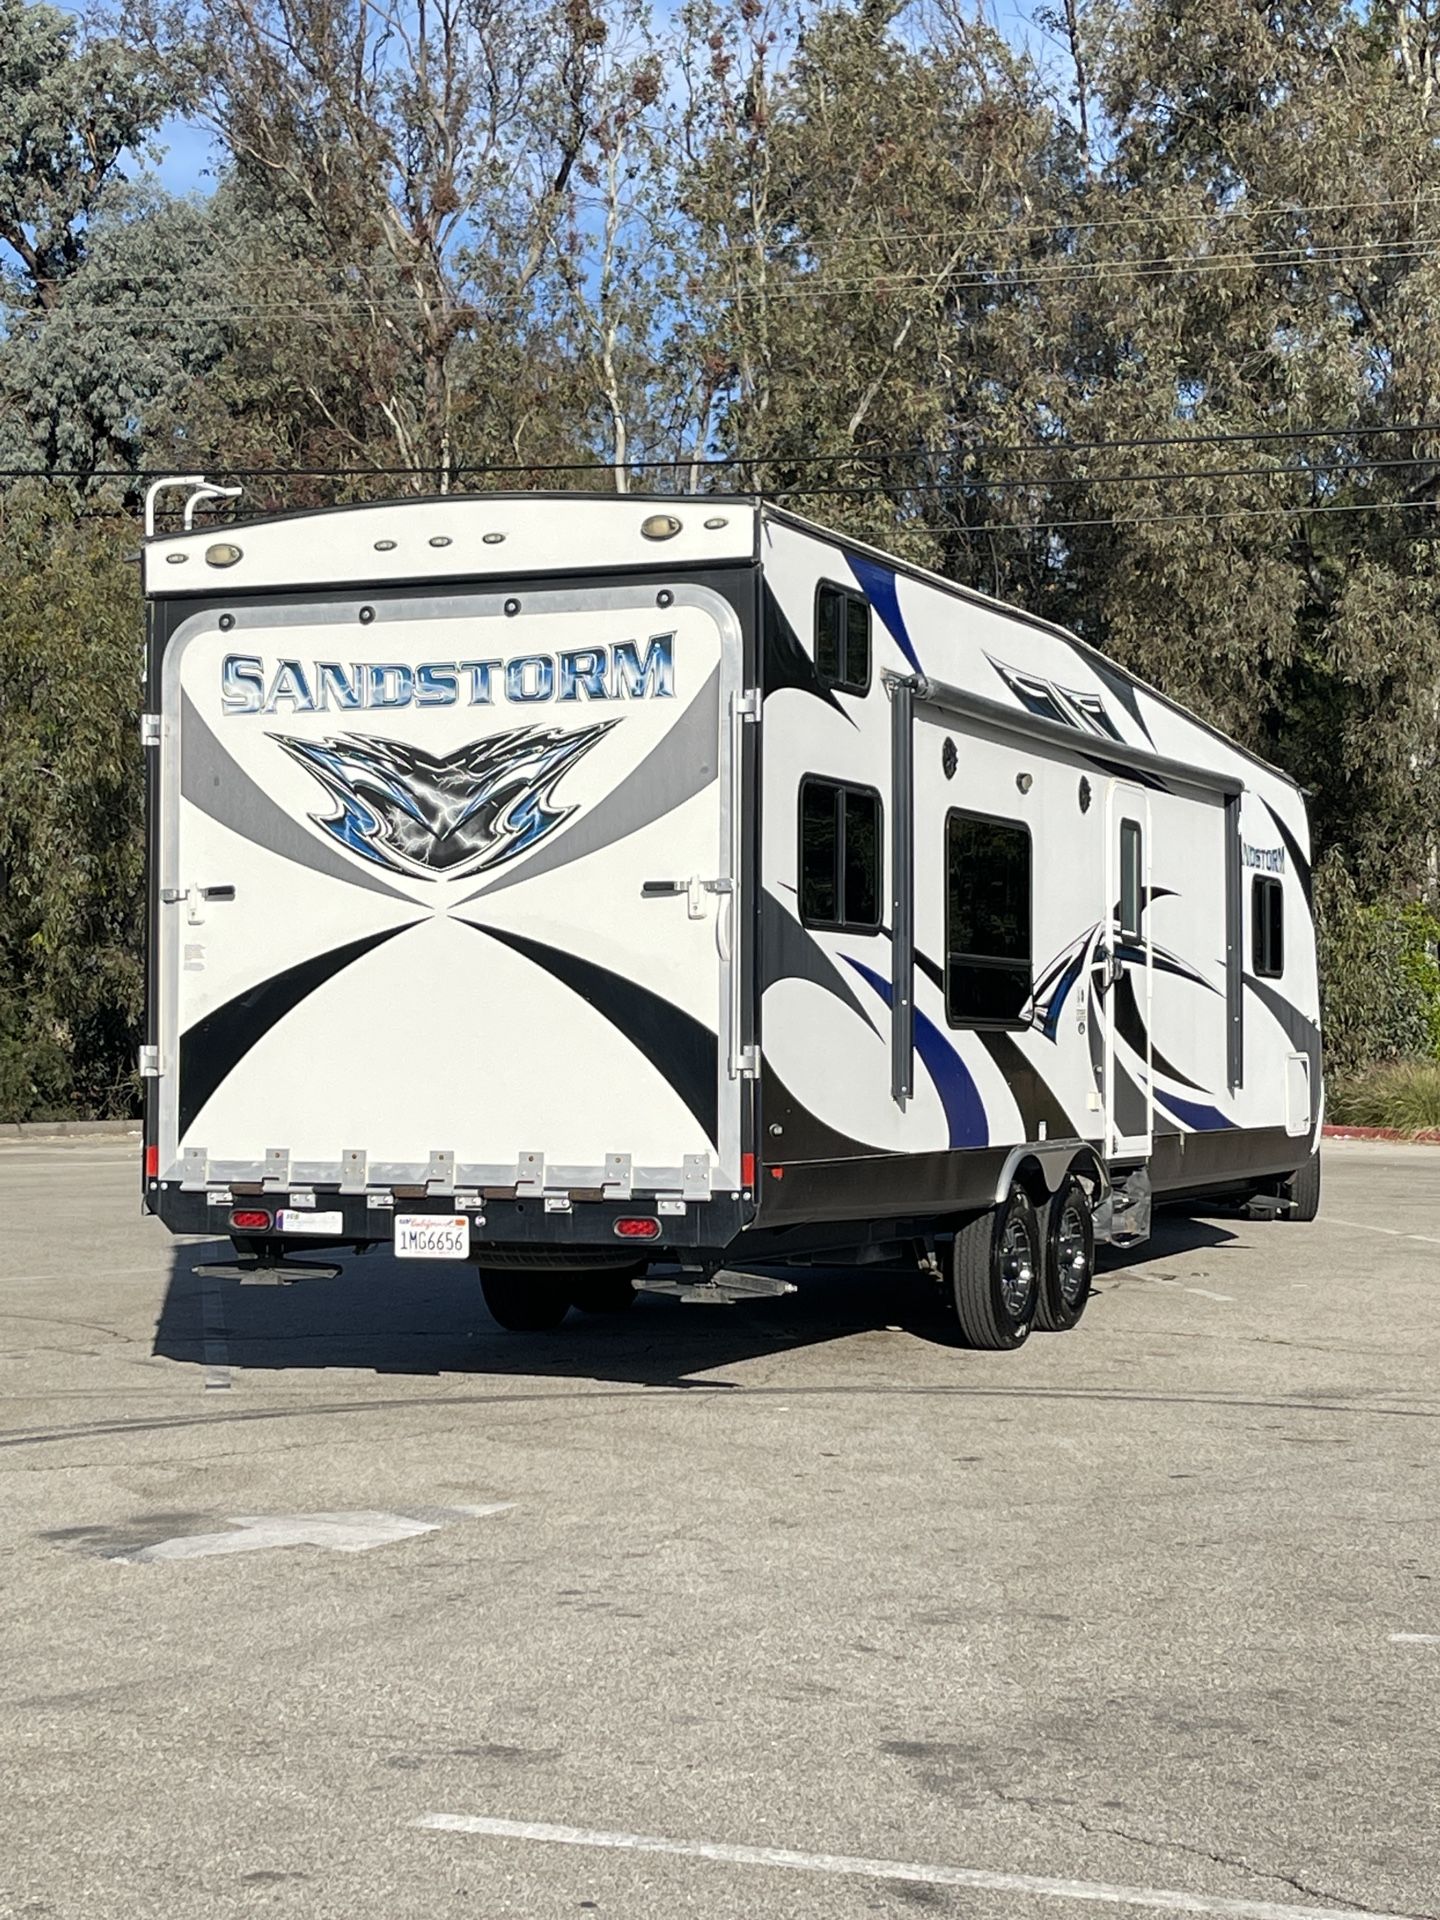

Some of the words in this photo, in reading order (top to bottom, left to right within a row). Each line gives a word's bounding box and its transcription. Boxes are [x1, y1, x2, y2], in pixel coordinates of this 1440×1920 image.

[222, 629, 678, 716] SANDSTORM
[1241, 842, 1285, 874] NDSTORM
[400, 1231, 463, 1250] 1MG6656
